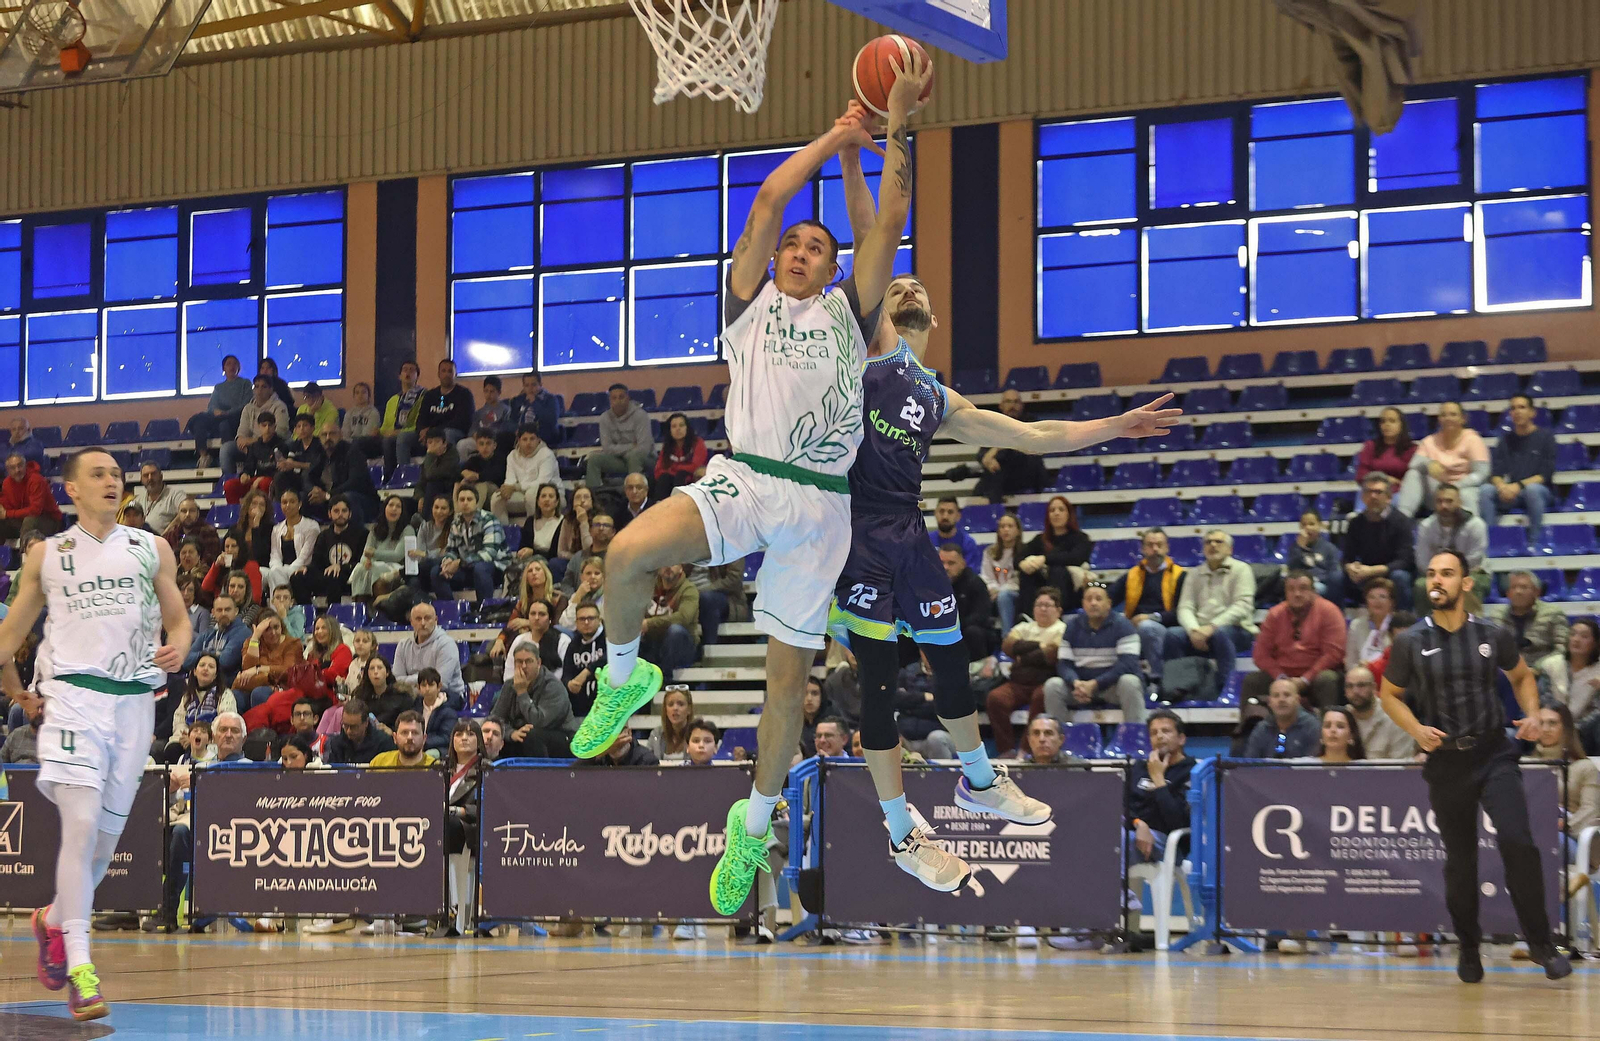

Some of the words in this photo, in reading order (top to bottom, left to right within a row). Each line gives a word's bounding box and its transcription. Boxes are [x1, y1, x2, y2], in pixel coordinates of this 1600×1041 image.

[701, 474, 739, 503] 32
[61, 555, 75, 576] 4
[63, 575, 135, 597] Lobe
[846, 583, 878, 610] 22
[61, 729, 76, 755] 4
[256, 796, 308, 810] MULTIPLE
[308, 796, 353, 812] MARKET
[354, 796, 382, 808] FOOD
[493, 820, 586, 856] Frida
[970, 841, 988, 859] DE
[989, 841, 1007, 859] LA
[1006, 841, 1051, 860] CARNE
[1330, 849, 1400, 860] MEDICINA
[14, 861, 35, 875] Can
[501, 857, 553, 867] BEAUTIFUL
[559, 857, 578, 867] PUB
[255, 878, 296, 891] PLAZA
[298, 876, 377, 891] ANDALUCÍA
